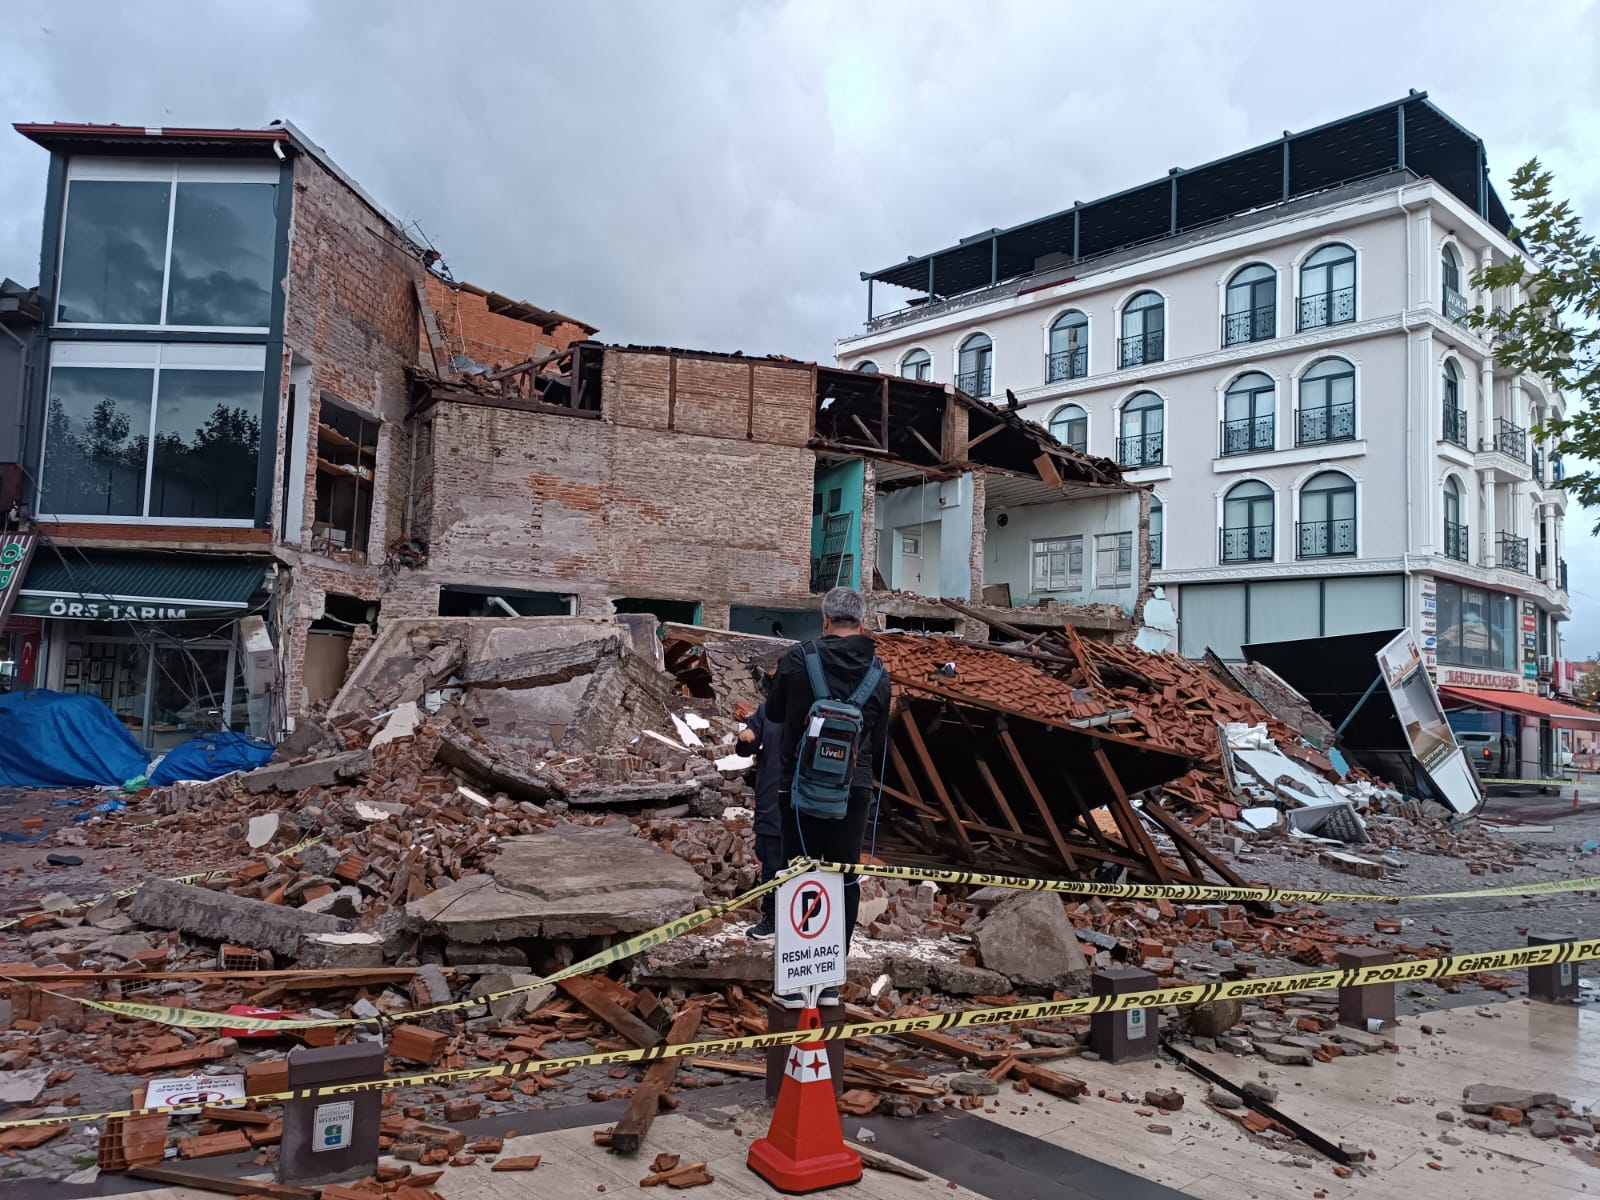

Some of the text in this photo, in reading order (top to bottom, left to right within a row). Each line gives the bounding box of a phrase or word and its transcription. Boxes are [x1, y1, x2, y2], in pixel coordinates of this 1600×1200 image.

[49, 599, 186, 619] ÖRS TARIM
[821, 746, 844, 759] LiveU
[782, 944, 839, 963] RESMİ ARAÇ
[787, 958, 836, 979] PARK YERİ
